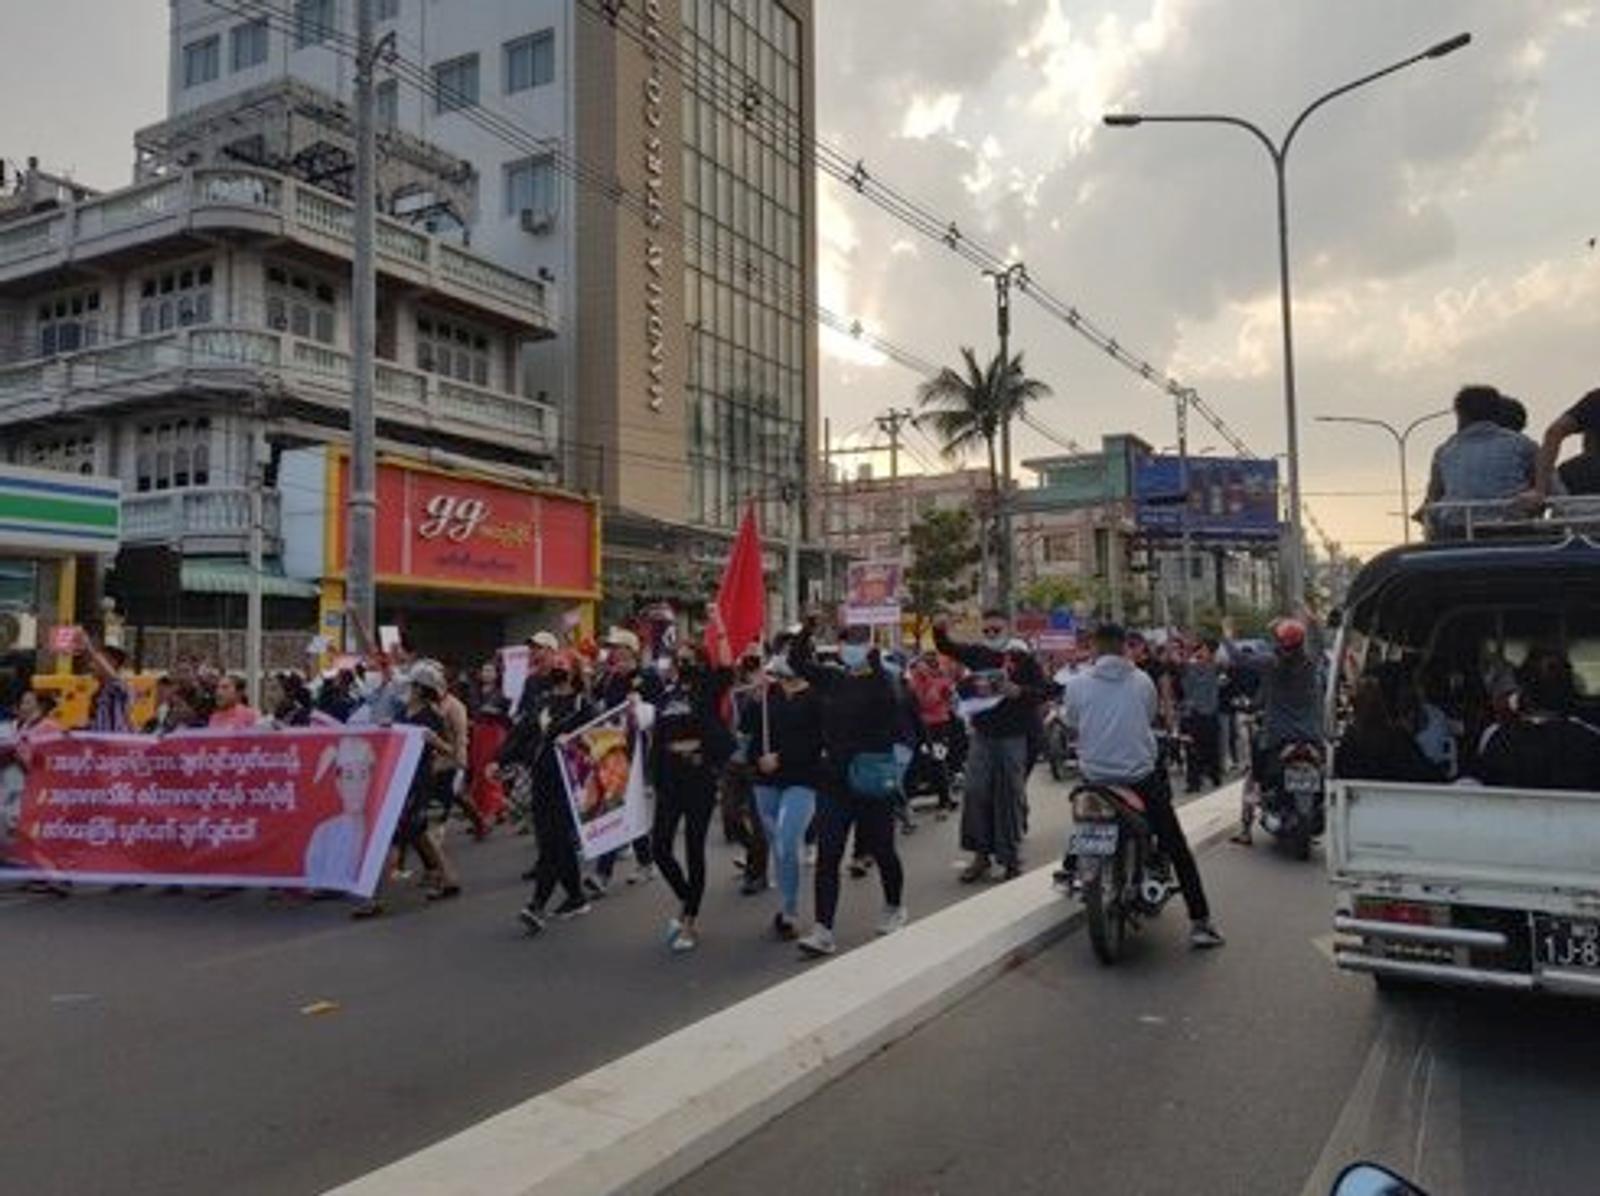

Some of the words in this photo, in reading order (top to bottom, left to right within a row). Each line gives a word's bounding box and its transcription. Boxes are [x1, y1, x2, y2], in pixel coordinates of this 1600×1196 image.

[645, 138, 664, 230] STARS
[645, 238, 664, 414] MANDALAY
[419, 494, 489, 542] gg
